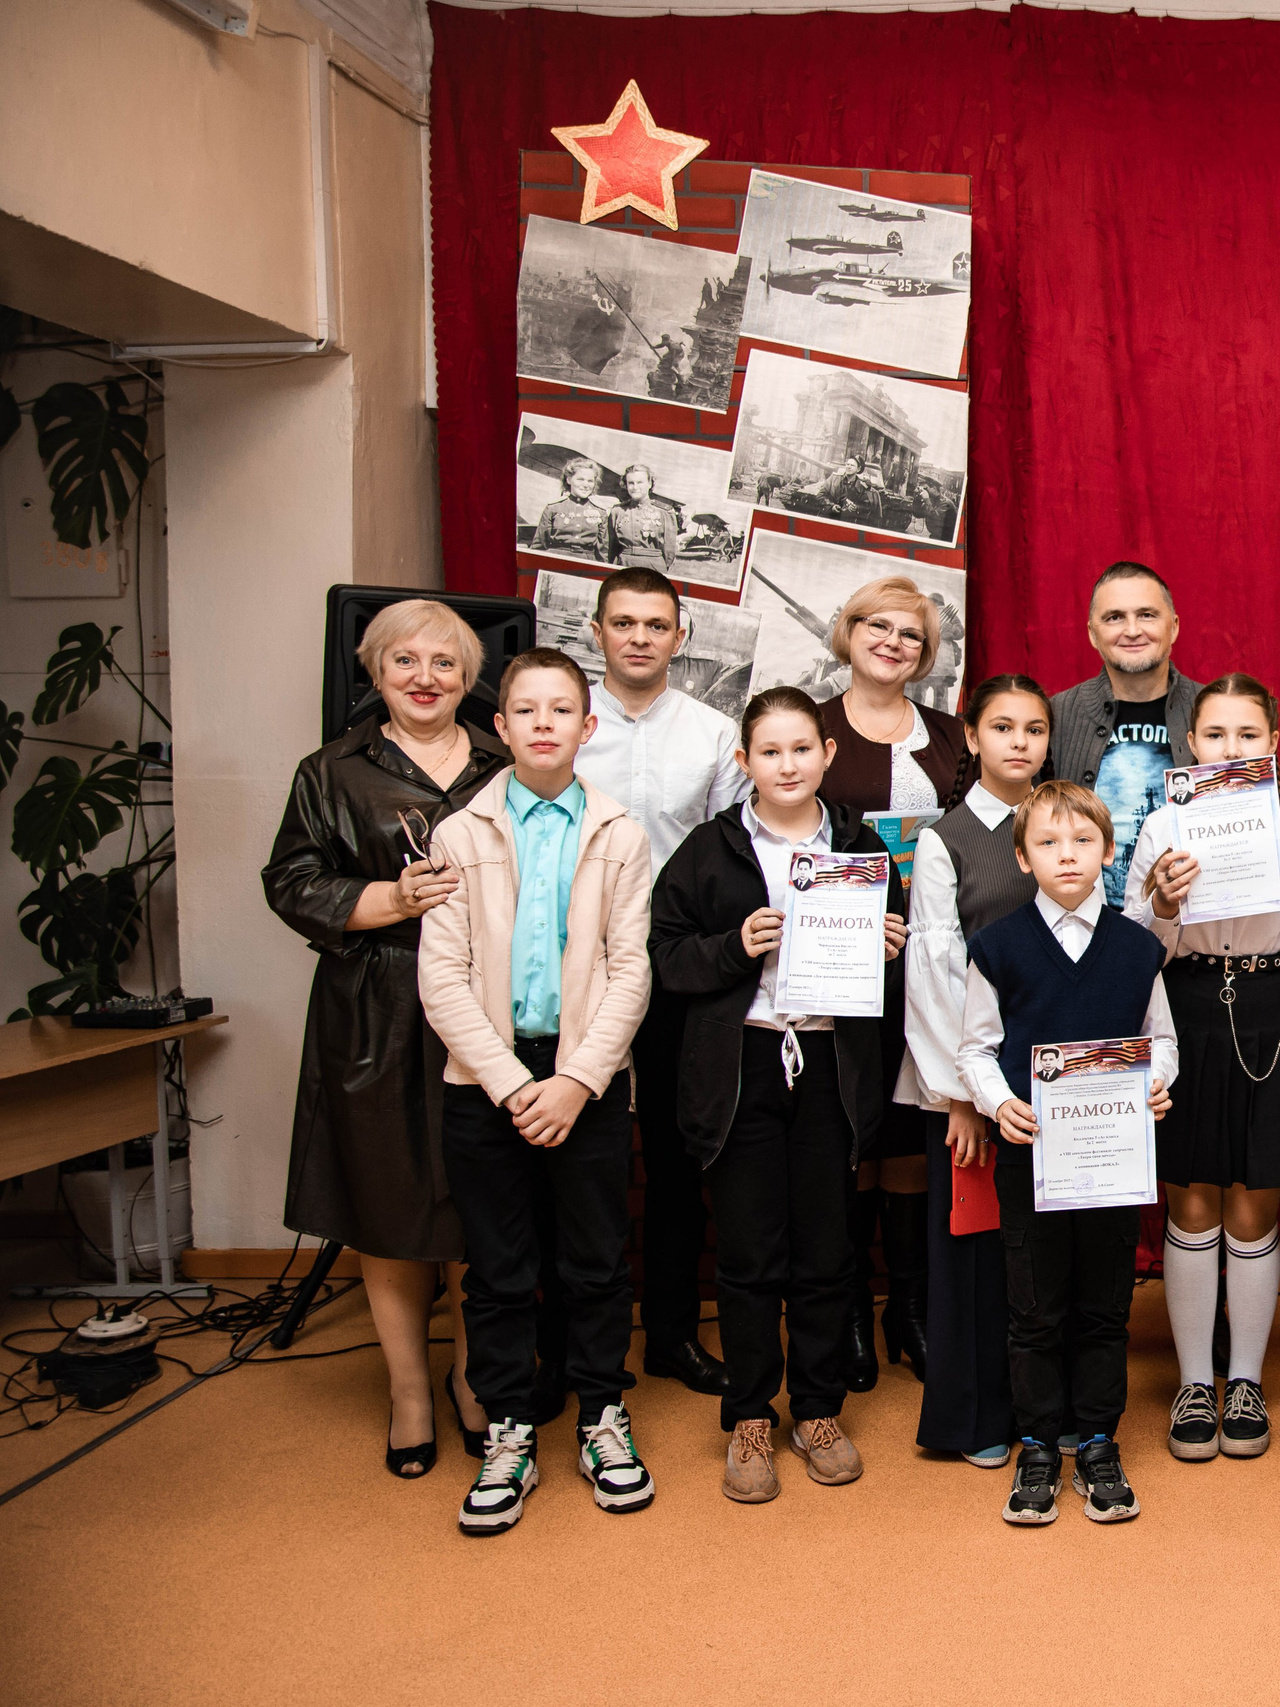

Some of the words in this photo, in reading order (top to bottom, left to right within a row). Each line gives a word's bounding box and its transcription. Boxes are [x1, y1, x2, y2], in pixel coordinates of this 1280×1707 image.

[898, 279, 912, 292] 25
[1108, 723, 1171, 745] АСТОП
[1188, 818, 1266, 840] ГРАМОТА
[799, 915, 874, 929] ГРАМОТА
[1051, 1101, 1137, 1120] ГРАМОТА
[1072, 1123, 1116, 1131] НАГРАЖДАЕТСЯ
